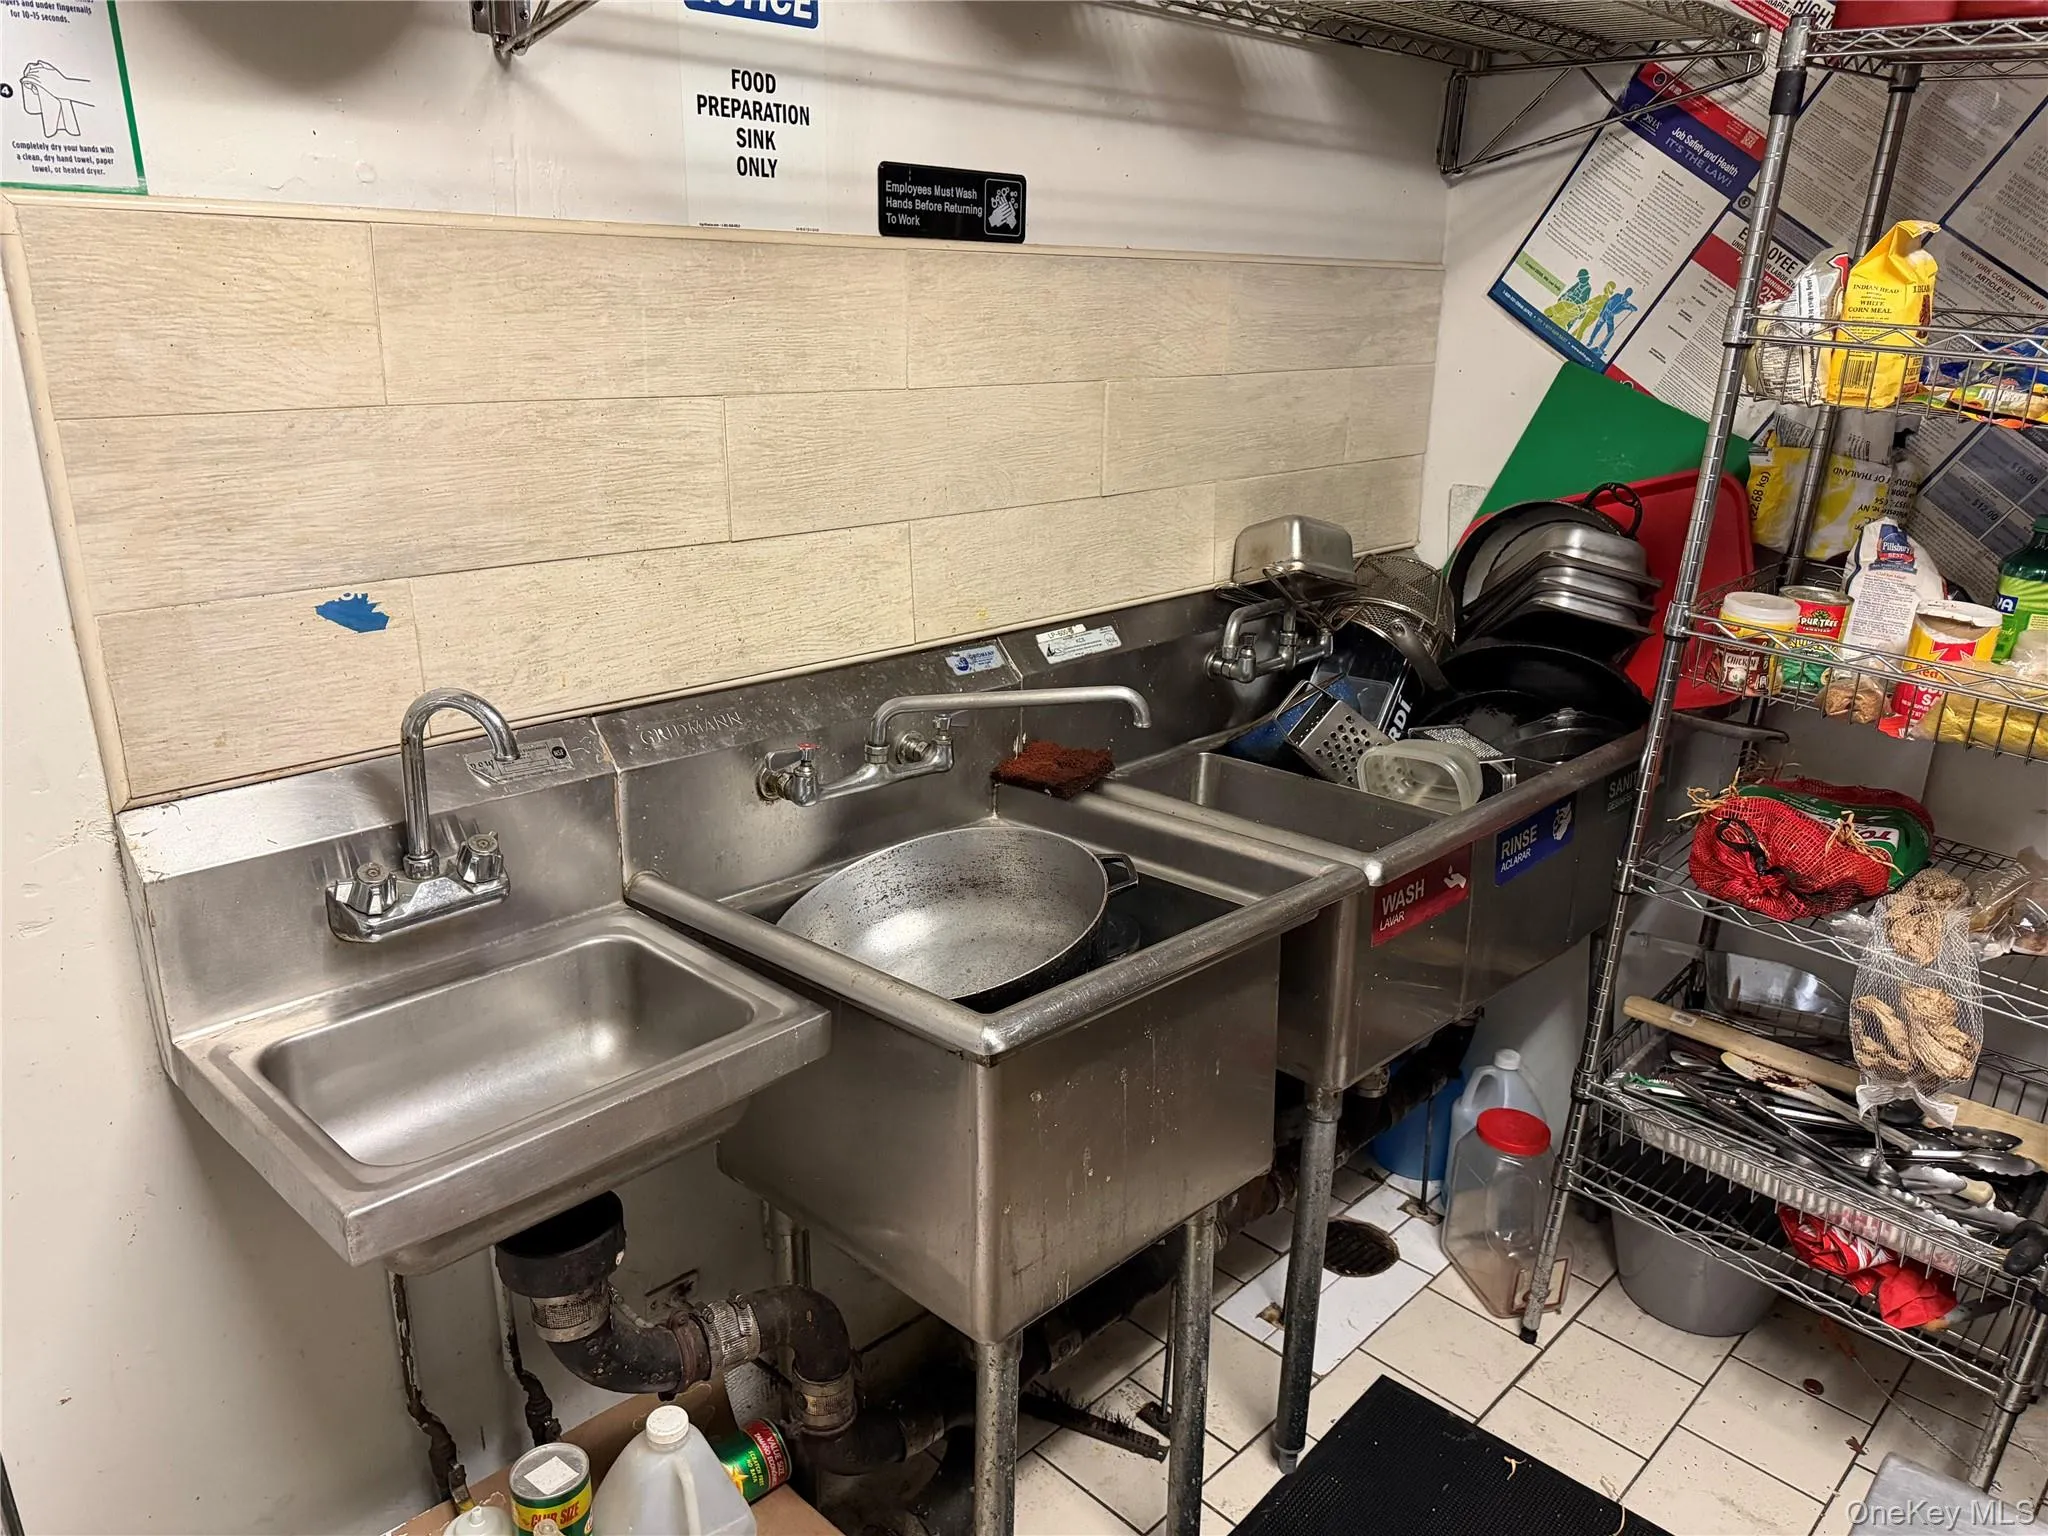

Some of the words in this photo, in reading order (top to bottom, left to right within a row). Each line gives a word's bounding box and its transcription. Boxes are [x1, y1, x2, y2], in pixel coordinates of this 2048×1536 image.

[10, 9, 20, 18] for
[22, 10, 40, 20] 10-15
[41, 14, 70, 24] seconds.
[36, 2, 54, 10] under
[56, 2, 92, 15] fingernails
[731, 68, 776, 94] FOOD
[696, 94, 810, 126] PREPARATION
[12, 141, 49, 150] Completely
[51, 143, 62, 152] dry
[80, 145, 98, 153] hands
[100, 146, 114, 154] with
[736, 127, 776, 150] SINK
[22, 153, 42, 162] clean,
[44, 154, 54, 163] dry
[56, 154, 73, 162] hand
[74, 156, 94, 164] towel,
[96, 158, 114, 166] paper
[1665, 137, 1685, 154] IT'S
[1684, 150, 1705, 168] THE
[1704, 164, 1734, 188] LAW!
[1672, 127, 1686, 140] Job
[1685, 134, 1705, 155] Safety
[1704, 148, 1719, 163] and
[1716, 154, 1738, 178] Health
[32, 164, 53, 174] towel,
[62, 166, 85, 174] heated
[86, 167, 106, 176] dryer.
[736, 156, 778, 178] ONLY
[886, 180, 932, 196] Employees
[934, 185, 954, 198] Must
[955, 187, 978, 200] Wash
[886, 198, 913, 209] Hands
[915, 200, 942, 212] Before
[944, 202, 983, 218] Returning
[886, 212, 897, 224] To
[898, 214, 920, 226] Work
[1770, 266, 1788, 283] LABOR
[1960, 250, 1974, 264] NEW
[1974, 260, 1993, 274] YORK
[1992, 272, 2032, 300] CORRECTION
[2030, 298, 2046, 312] LAW
[1853, 284, 1878, 292] INDIAN
[1880, 286, 1900, 294] HEAD
[1976, 273, 2004, 292] ARTICLE
[2001, 290, 2016, 302] 23-A
[1848, 306, 1868, 314] CORN
[1832, 467, 1873, 481] THAILAND
[1858, 504, 1870, 512] NY
[1882, 540, 1910, 554] Pillsbury
[1819, 619, 1839, 628] TREE
[1726, 654, 1756, 668] CHICKN
[1608, 770, 1638, 799] SANIT
[1500, 824, 1538, 860] RINSE
[1500, 848, 1532, 872] ACLARAR
[1382, 878, 1425, 916] WASH
[1379, 912, 1405, 932] LAVAR
[748, 1450, 762, 1473] SCRATCH
[767, 1436, 782, 1460] VALUE
[776, 1458, 784, 1477] SIZE
[560, 1501, 580, 1524] SIZE
